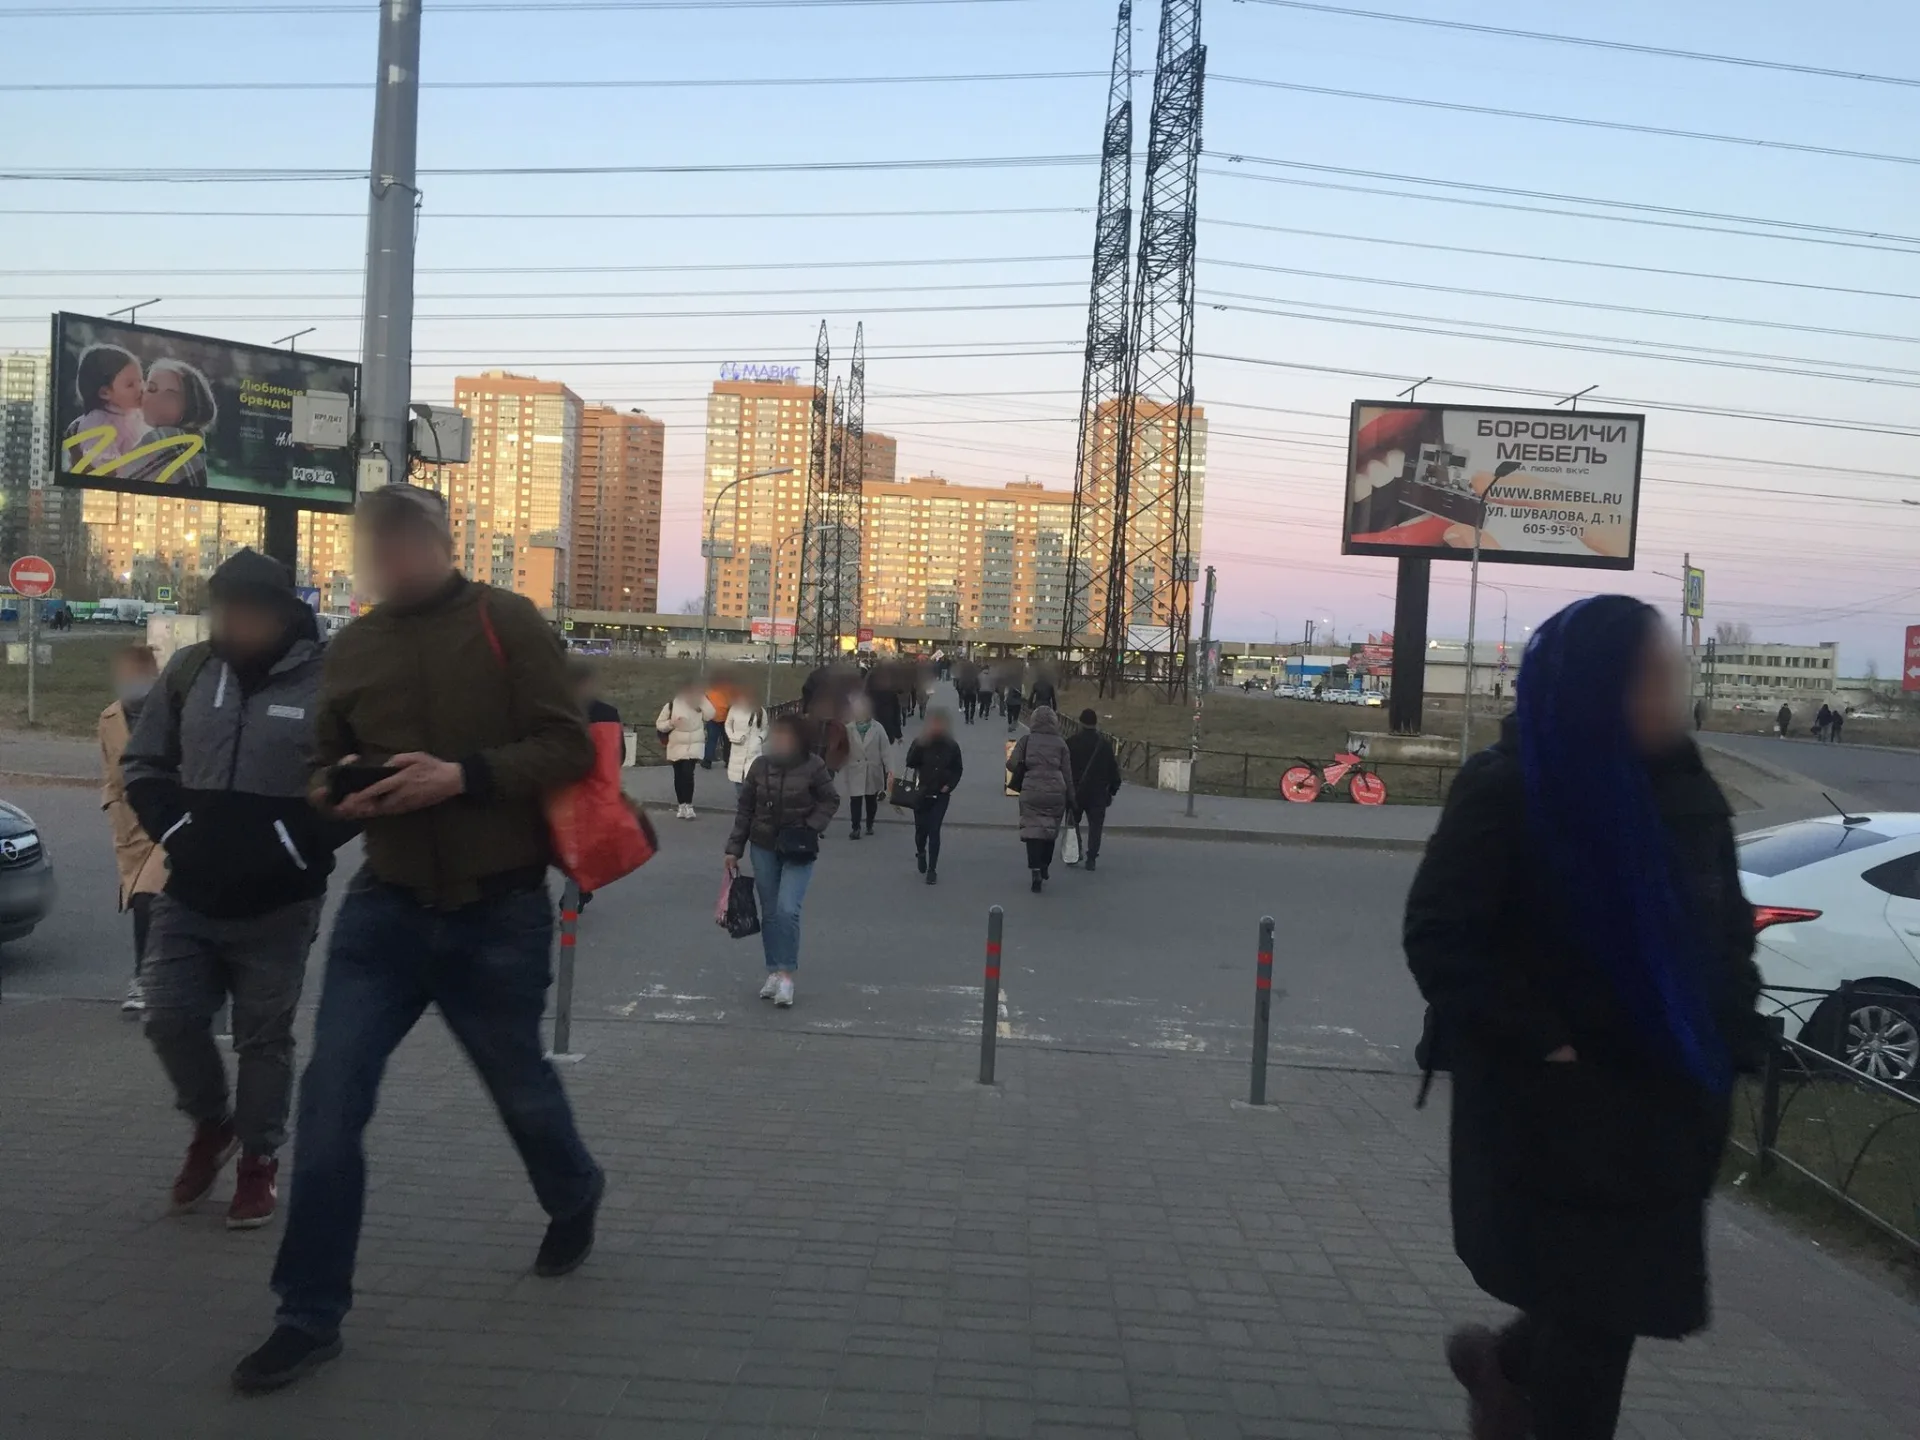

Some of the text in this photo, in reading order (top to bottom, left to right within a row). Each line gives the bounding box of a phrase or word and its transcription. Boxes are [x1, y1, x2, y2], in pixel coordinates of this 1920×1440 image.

[239, 379, 304, 397] Любимые
[239, 392, 291, 410] бренды
[1477, 419, 1627, 443] БОРОВИЧИ
[1496, 442, 1608, 465] МЕБЕЛЬ
[1531, 464, 1563, 474] ЛЮБОЙ
[1566, 466, 1590, 475] ВКУС
[1489, 486, 1622, 505] WWW.BRMEBEL.RU
[1487, 506, 1622, 525] УЛ. ШУВАЛОВА, Д. 11
[1522, 523, 1585, 537] 605-95-01
